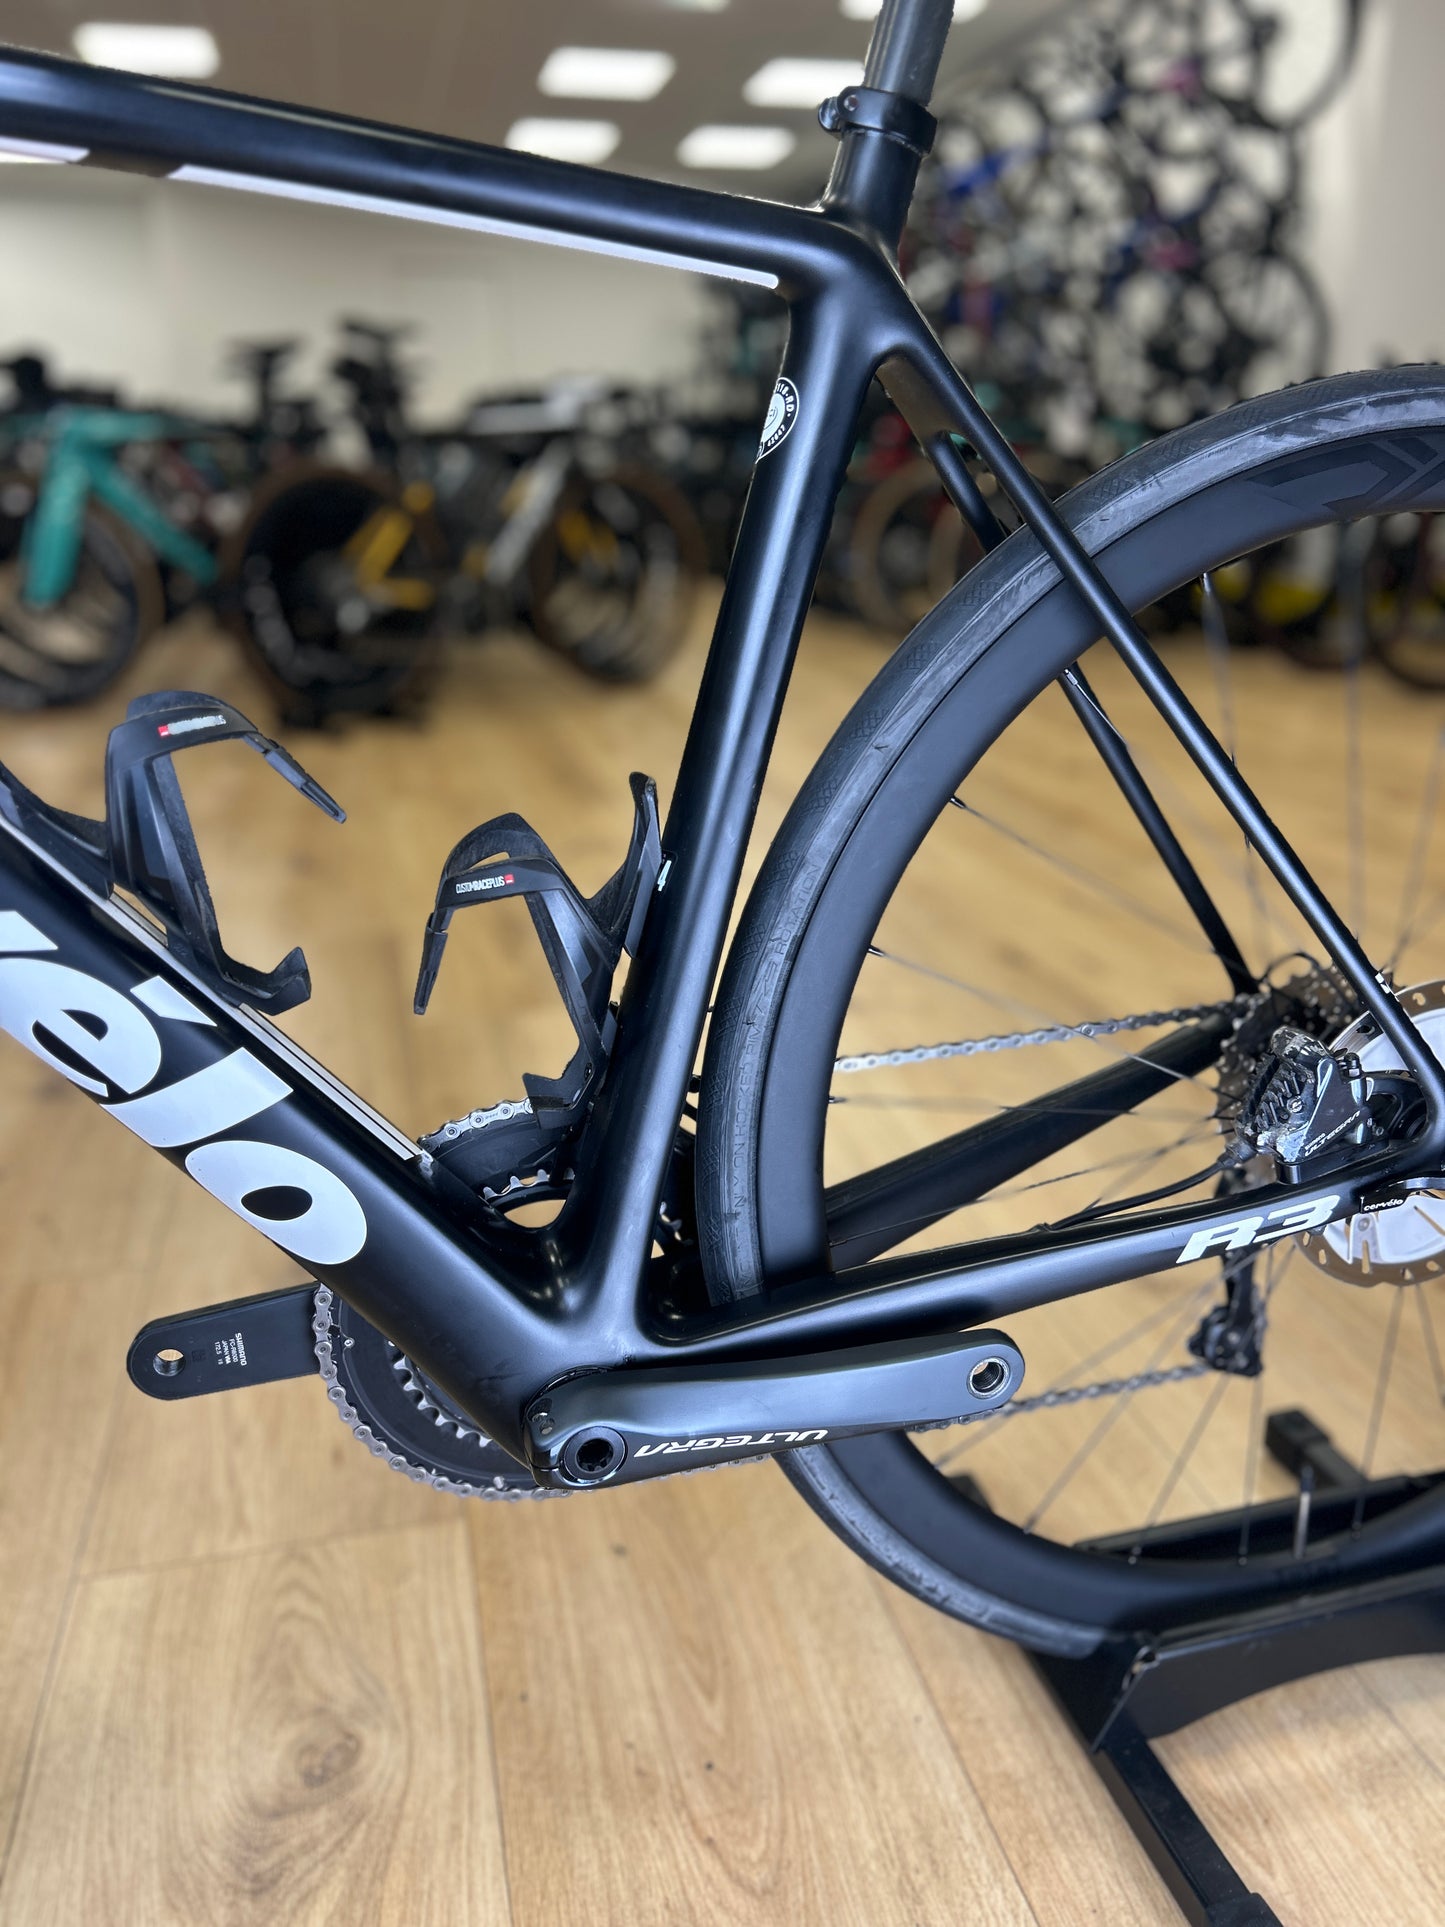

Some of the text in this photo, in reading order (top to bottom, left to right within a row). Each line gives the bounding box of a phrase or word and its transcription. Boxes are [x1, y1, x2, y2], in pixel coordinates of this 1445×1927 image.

[1175, 1194, 1342, 1264] R3
[235, 1332, 247, 1366] SHIMANO
[633, 1429, 829, 1458] ULTEGRA
